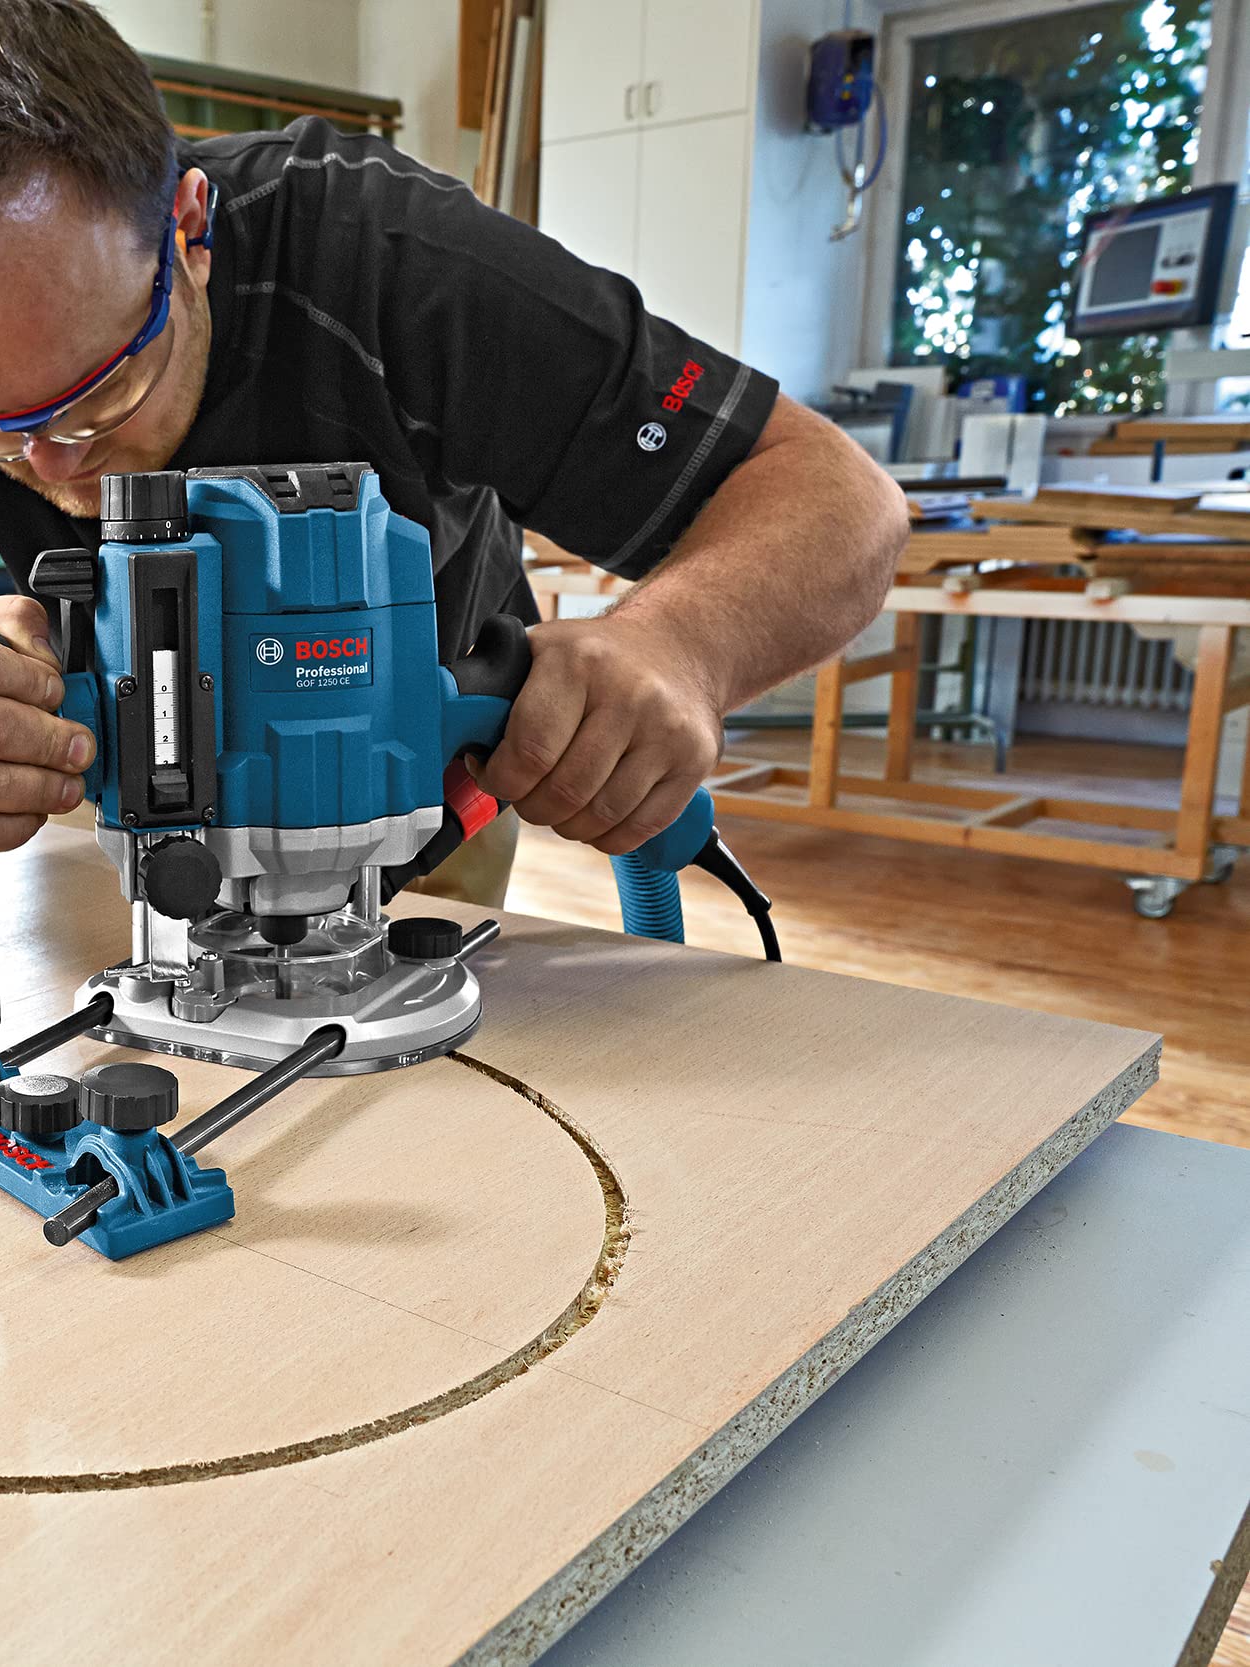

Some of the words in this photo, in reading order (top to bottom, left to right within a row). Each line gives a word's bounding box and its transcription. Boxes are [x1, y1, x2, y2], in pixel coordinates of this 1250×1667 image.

[662, 360, 705, 412] BOSCH
[165, 520, 172, 529] 0
[296, 637, 367, 660] BOSCH
[296, 662, 368, 678] Professional
[296, 679, 315, 688] GOF
[318, 678, 338, 687] 1250
[339, 677, 350, 685] CE
[162, 735, 169, 743] 2
